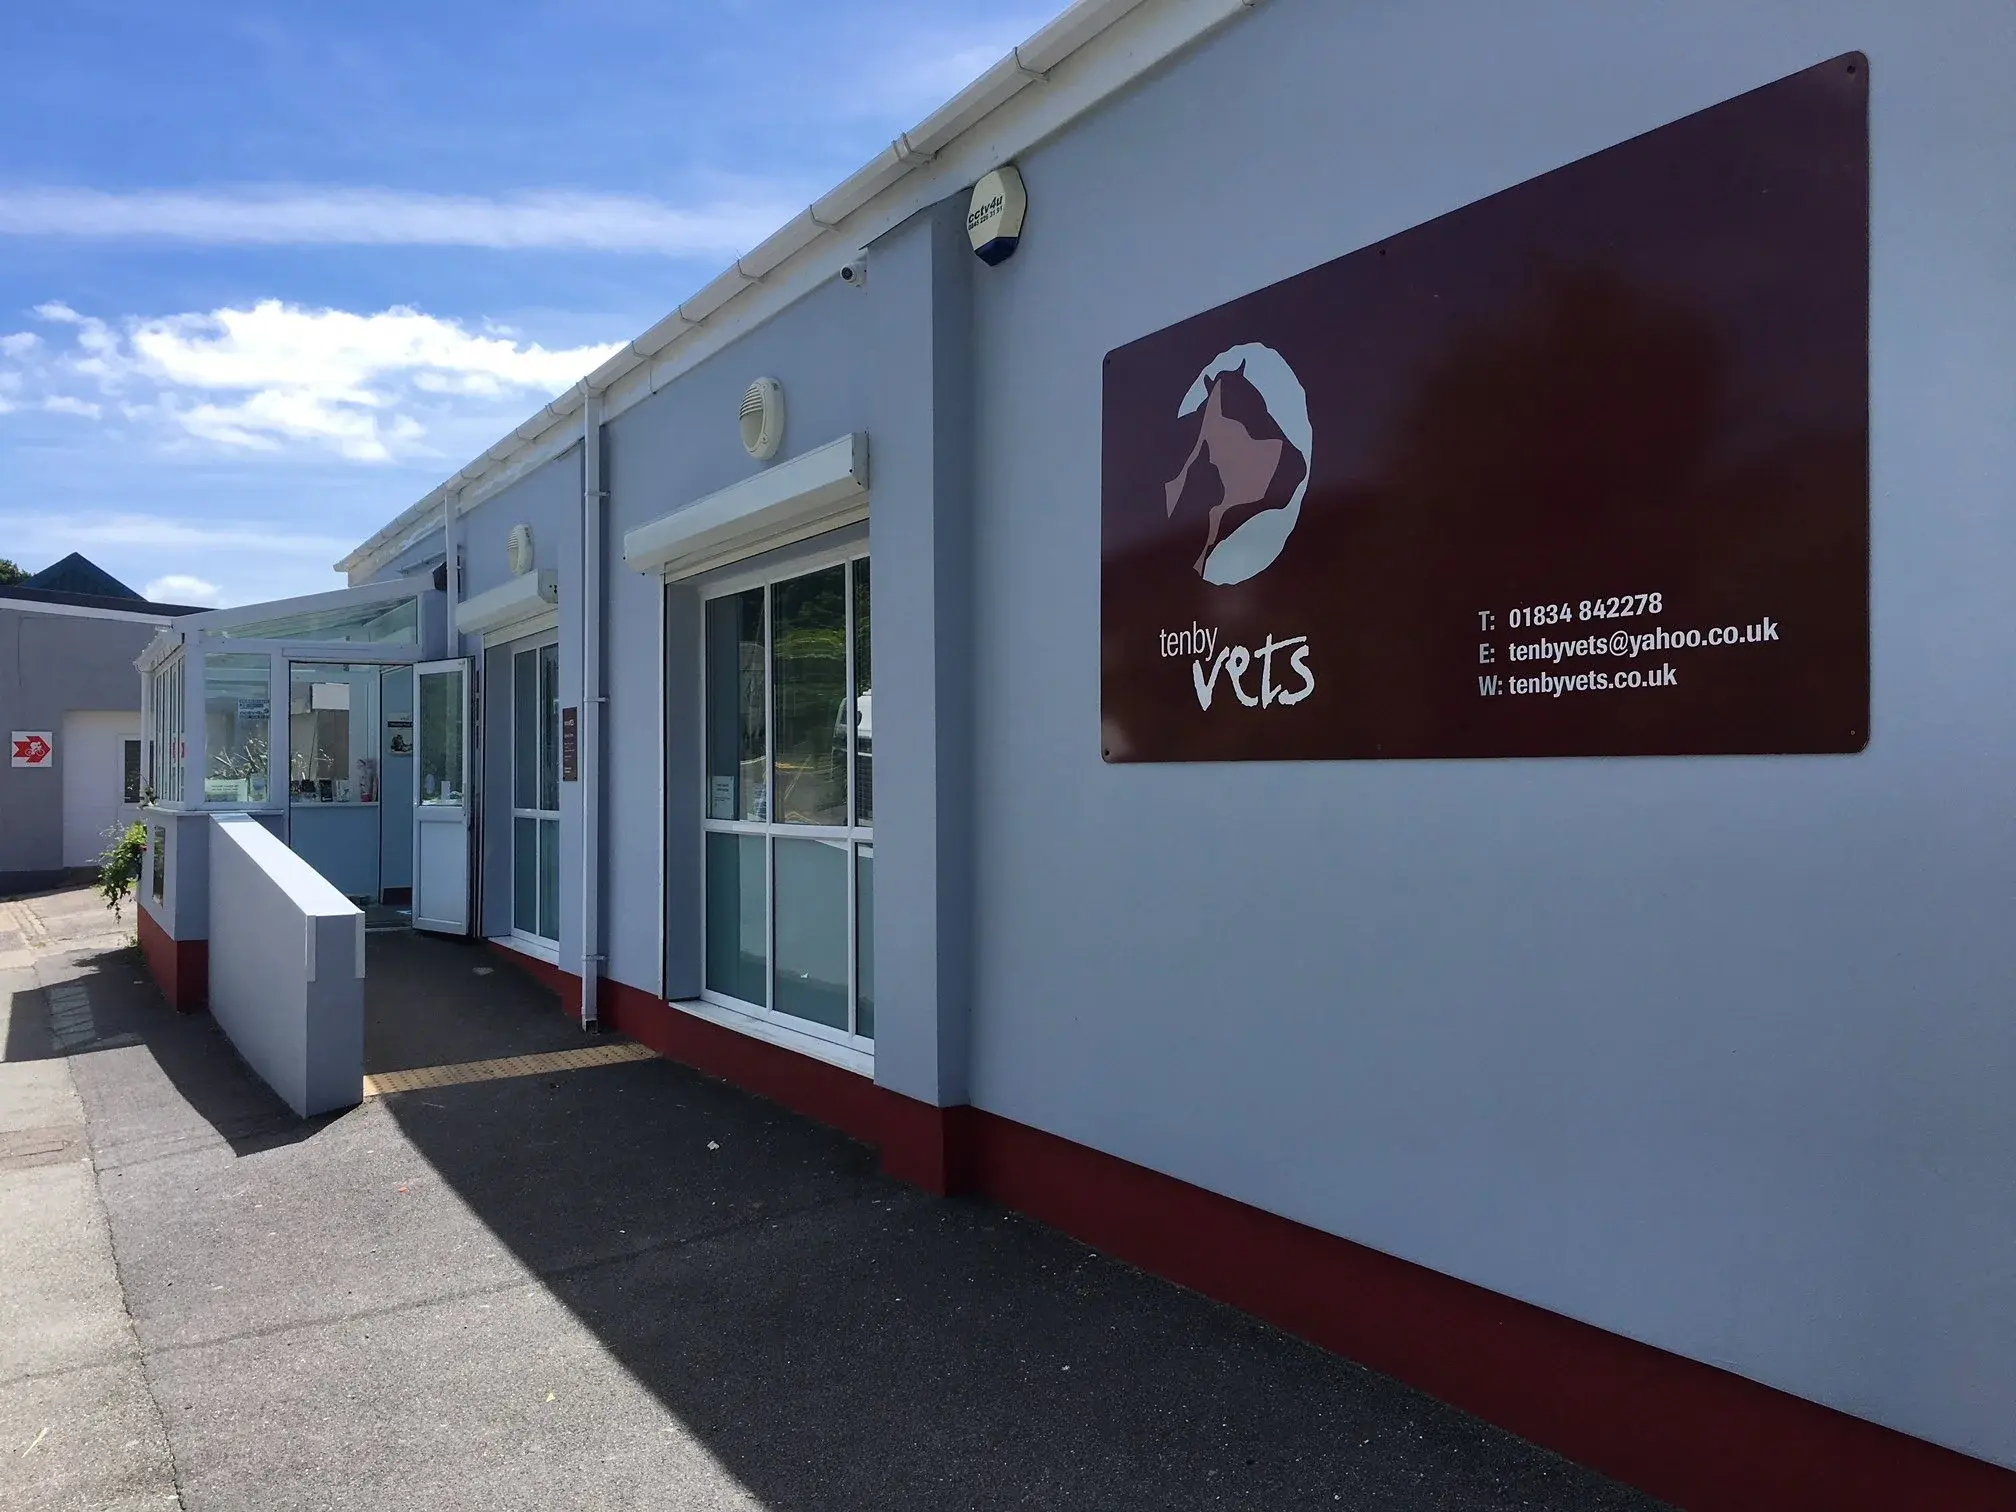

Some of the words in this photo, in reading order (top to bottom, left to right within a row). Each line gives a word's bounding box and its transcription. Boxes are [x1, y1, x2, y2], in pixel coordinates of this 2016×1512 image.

[968, 196, 1003, 223] cctv4u
[1478, 611, 1495, 631] T:
[1509, 602, 1572, 629] 01834
[1578, 592, 1663, 620] 842278
[1159, 621, 1218, 662] tenby
[1479, 643, 1495, 664] E:
[1509, 617, 1779, 664] tenbyvets@yahoo.co.uk
[1192, 633, 1315, 711] vets
[1478, 675, 1503, 696] W:
[1509, 663, 1678, 698] tenbyvets.co.uk
